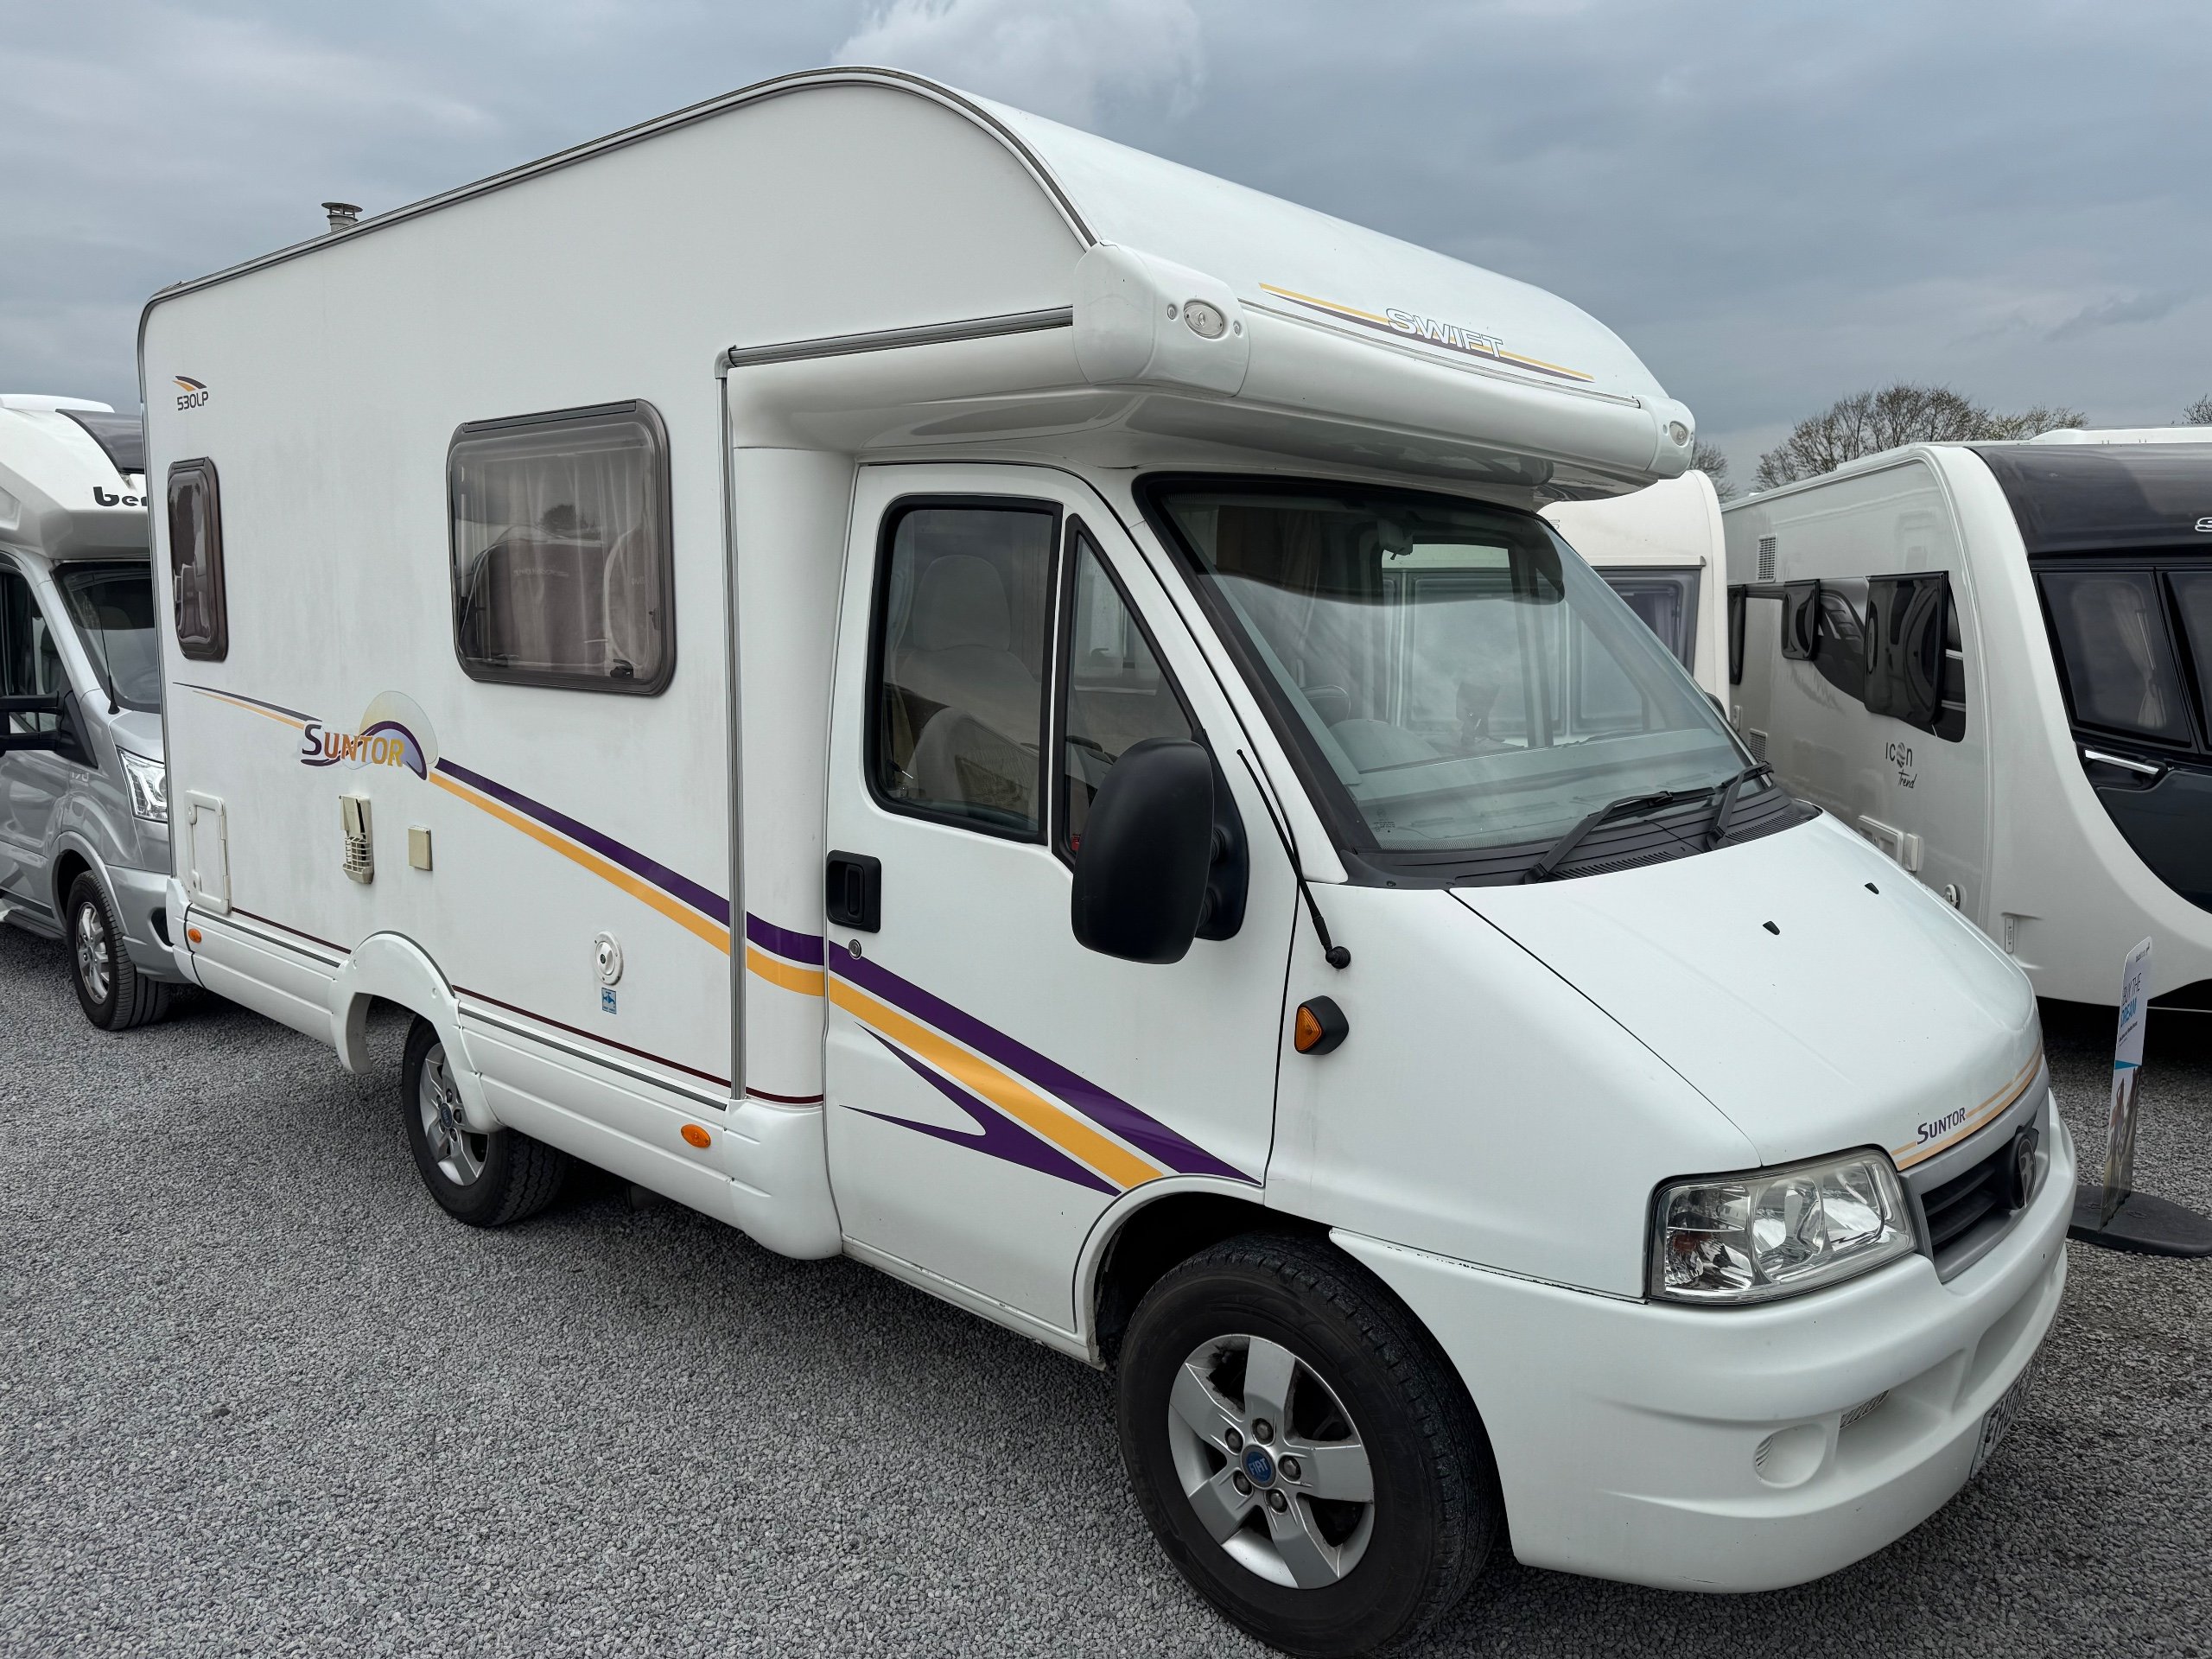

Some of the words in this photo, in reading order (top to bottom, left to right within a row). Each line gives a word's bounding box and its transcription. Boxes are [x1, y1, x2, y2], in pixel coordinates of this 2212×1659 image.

[1386, 308, 1503, 359] SWIFT
[176, 391, 209, 411] 530LP
[302, 723, 405, 767] SUNTOR
[1916, 1107, 1966, 1146] SUNTOR
[1248, 1457, 1268, 1476] FIAT
